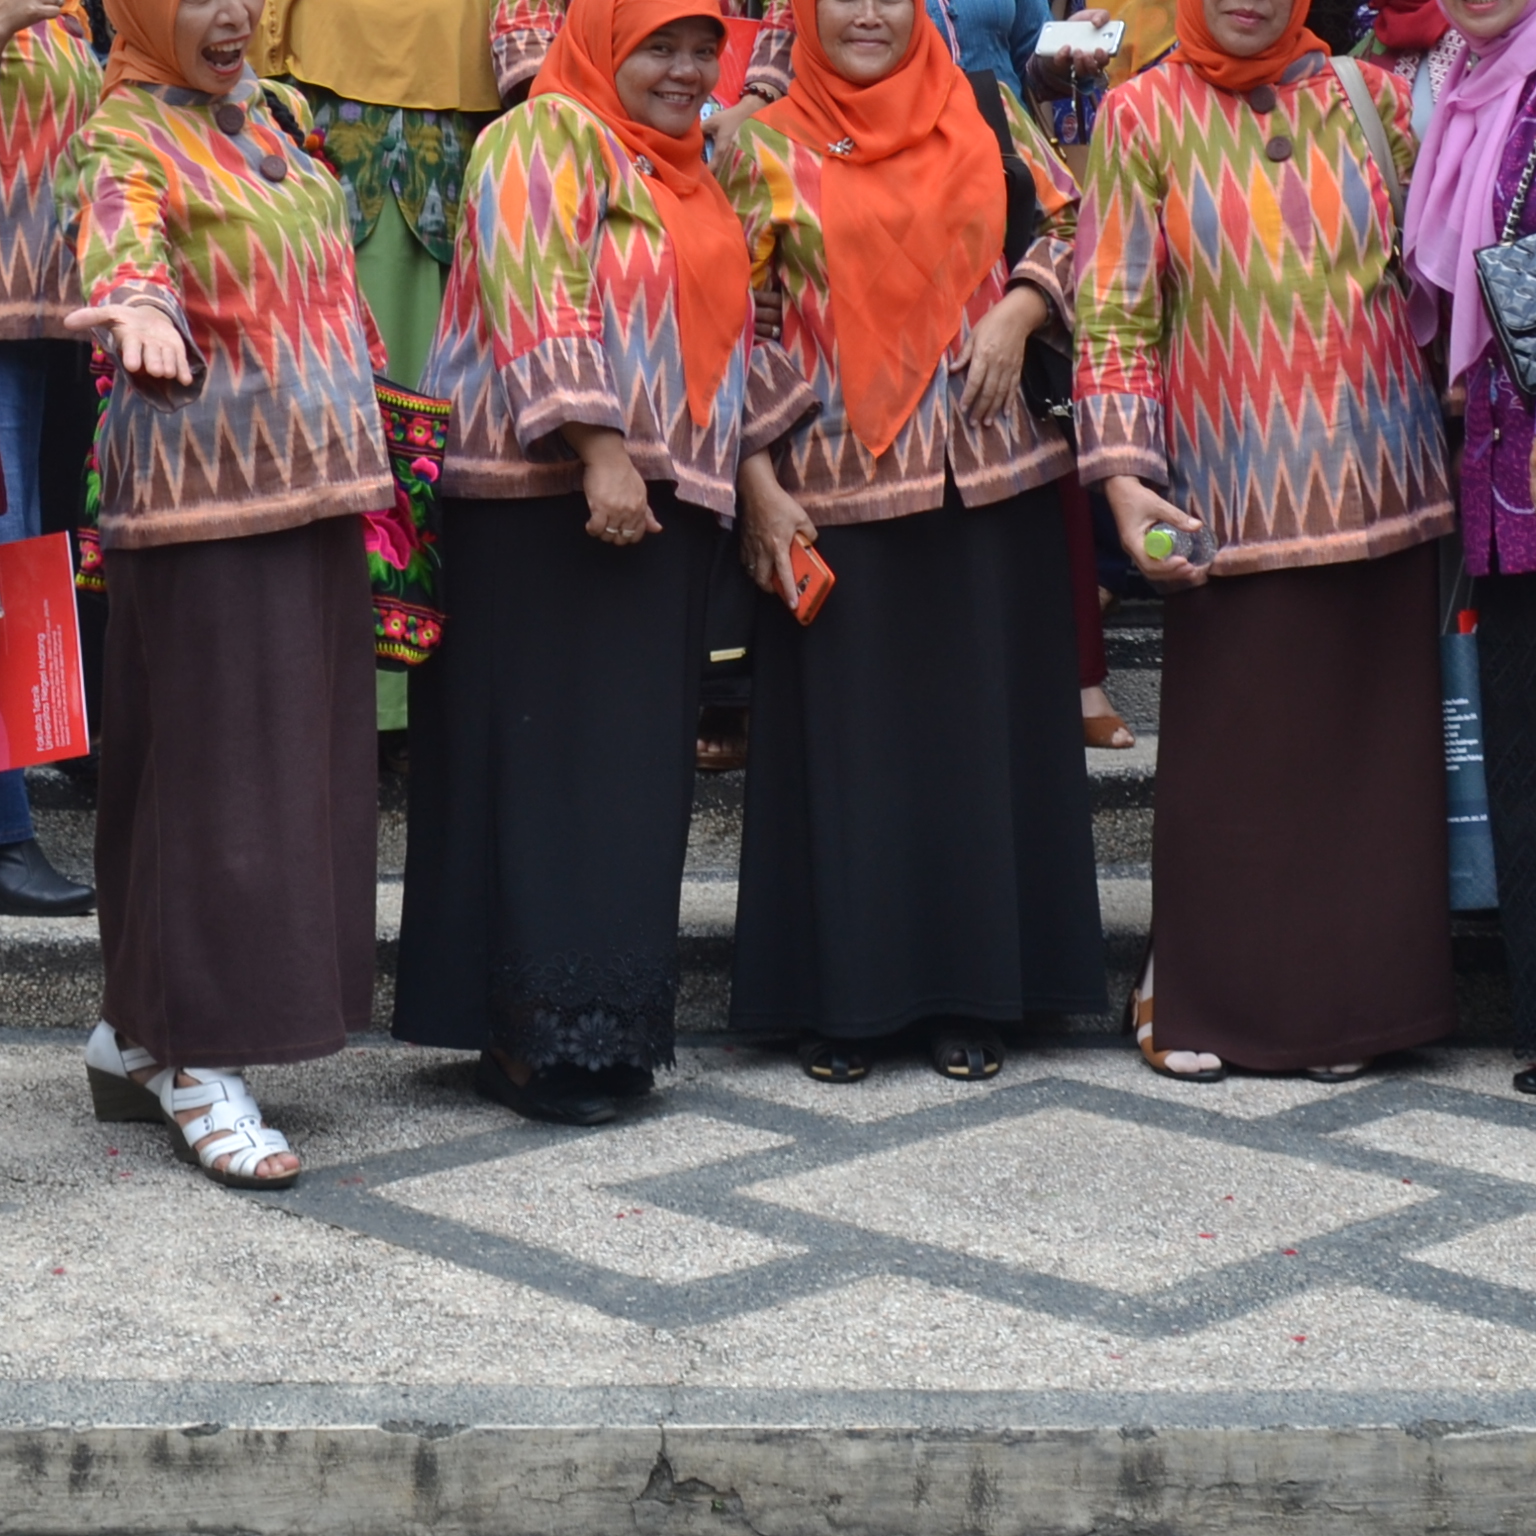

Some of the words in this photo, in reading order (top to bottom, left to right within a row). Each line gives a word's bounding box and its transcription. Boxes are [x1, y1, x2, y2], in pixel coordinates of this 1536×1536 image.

[36, 633, 47, 669] Malang
[31, 685, 42, 713] Teknik
[38, 671, 50, 701] Negeri
[35, 714, 45, 751] Fakultas
[40, 702, 53, 751] Universitas
